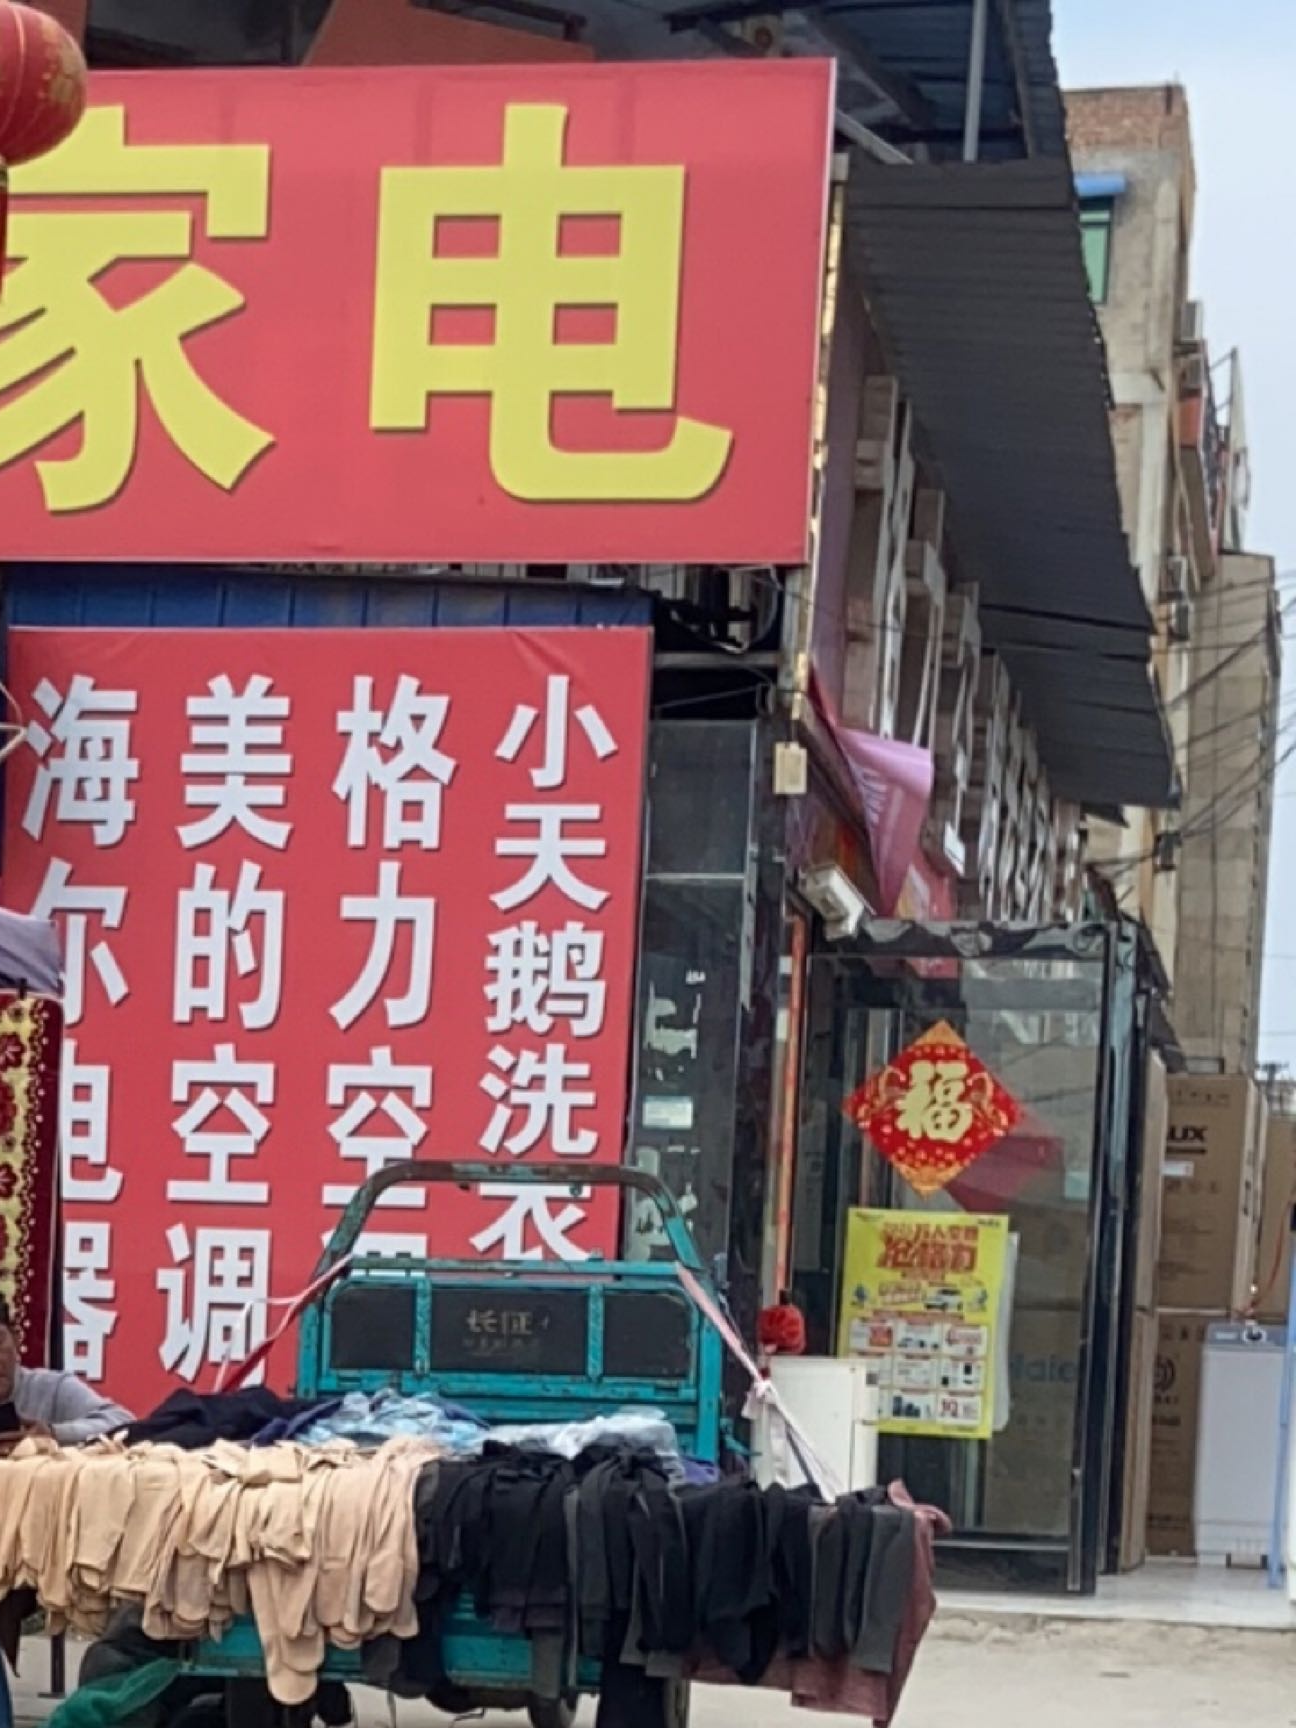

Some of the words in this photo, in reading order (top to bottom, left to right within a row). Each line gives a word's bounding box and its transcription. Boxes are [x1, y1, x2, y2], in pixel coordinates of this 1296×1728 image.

[156, 673, 294, 1385] 美的空调
[894, 1061, 973, 1143] 福
